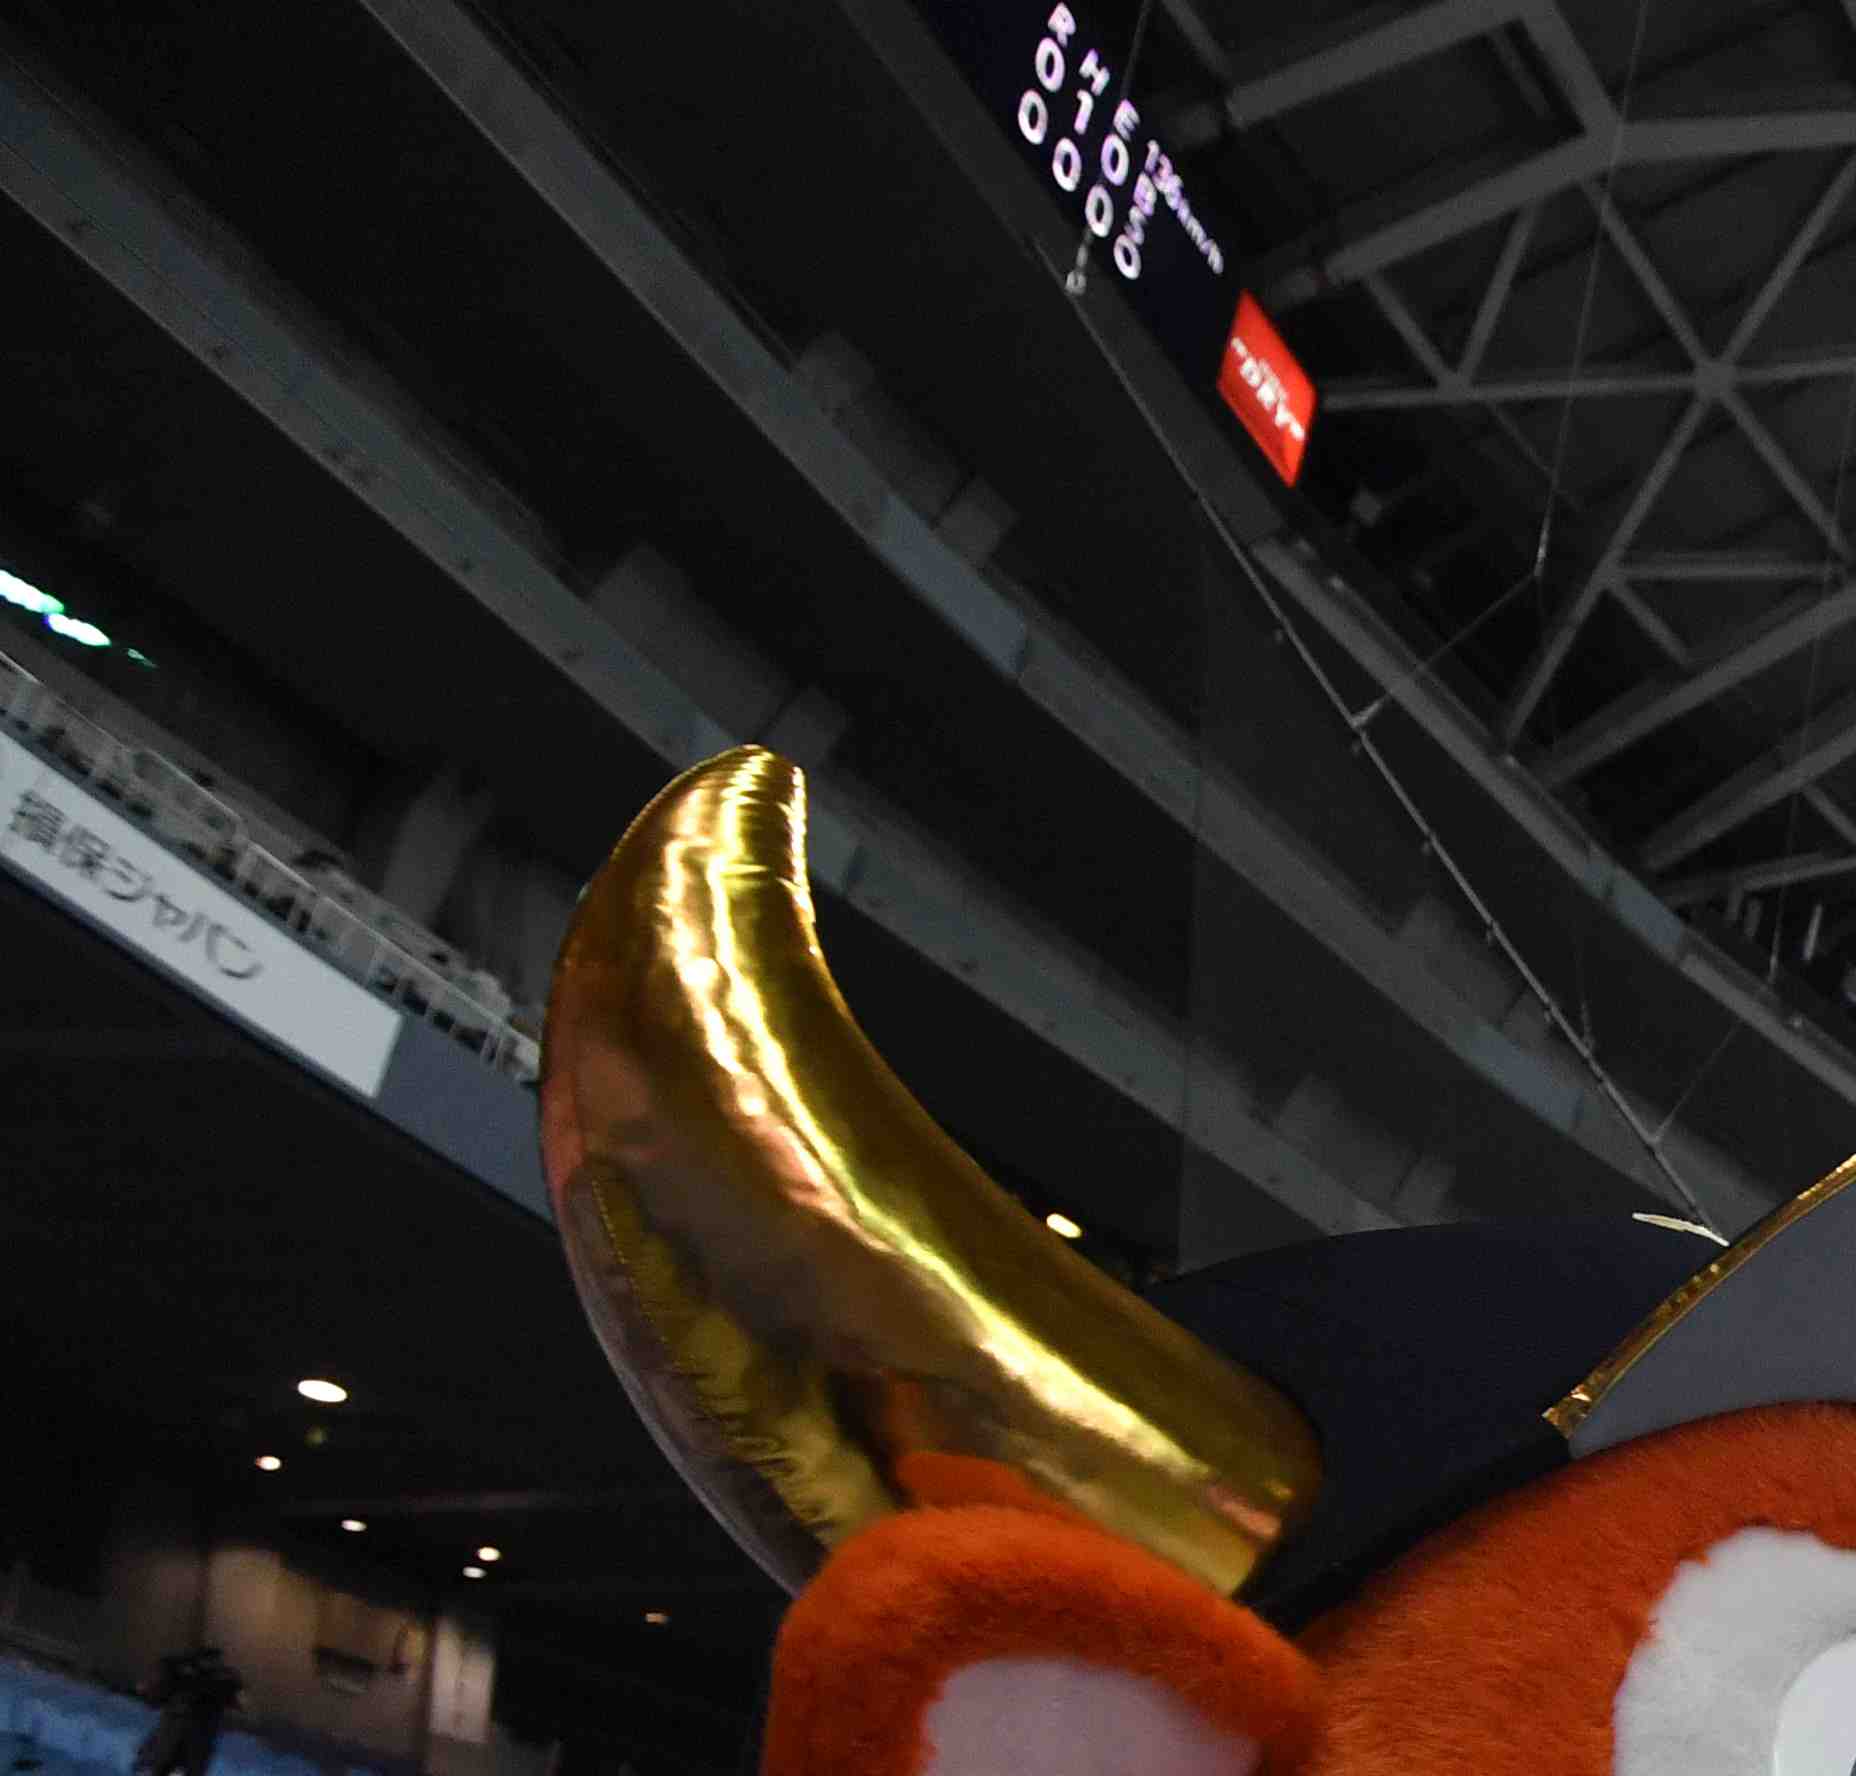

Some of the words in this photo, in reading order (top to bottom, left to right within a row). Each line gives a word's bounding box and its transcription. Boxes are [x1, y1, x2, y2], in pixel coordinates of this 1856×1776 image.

[1048, 2, 1076, 46] R
[1079, 49, 1110, 96] H
[1113, 98, 1140, 140] E
[1074, 90, 1094, 135] 1
